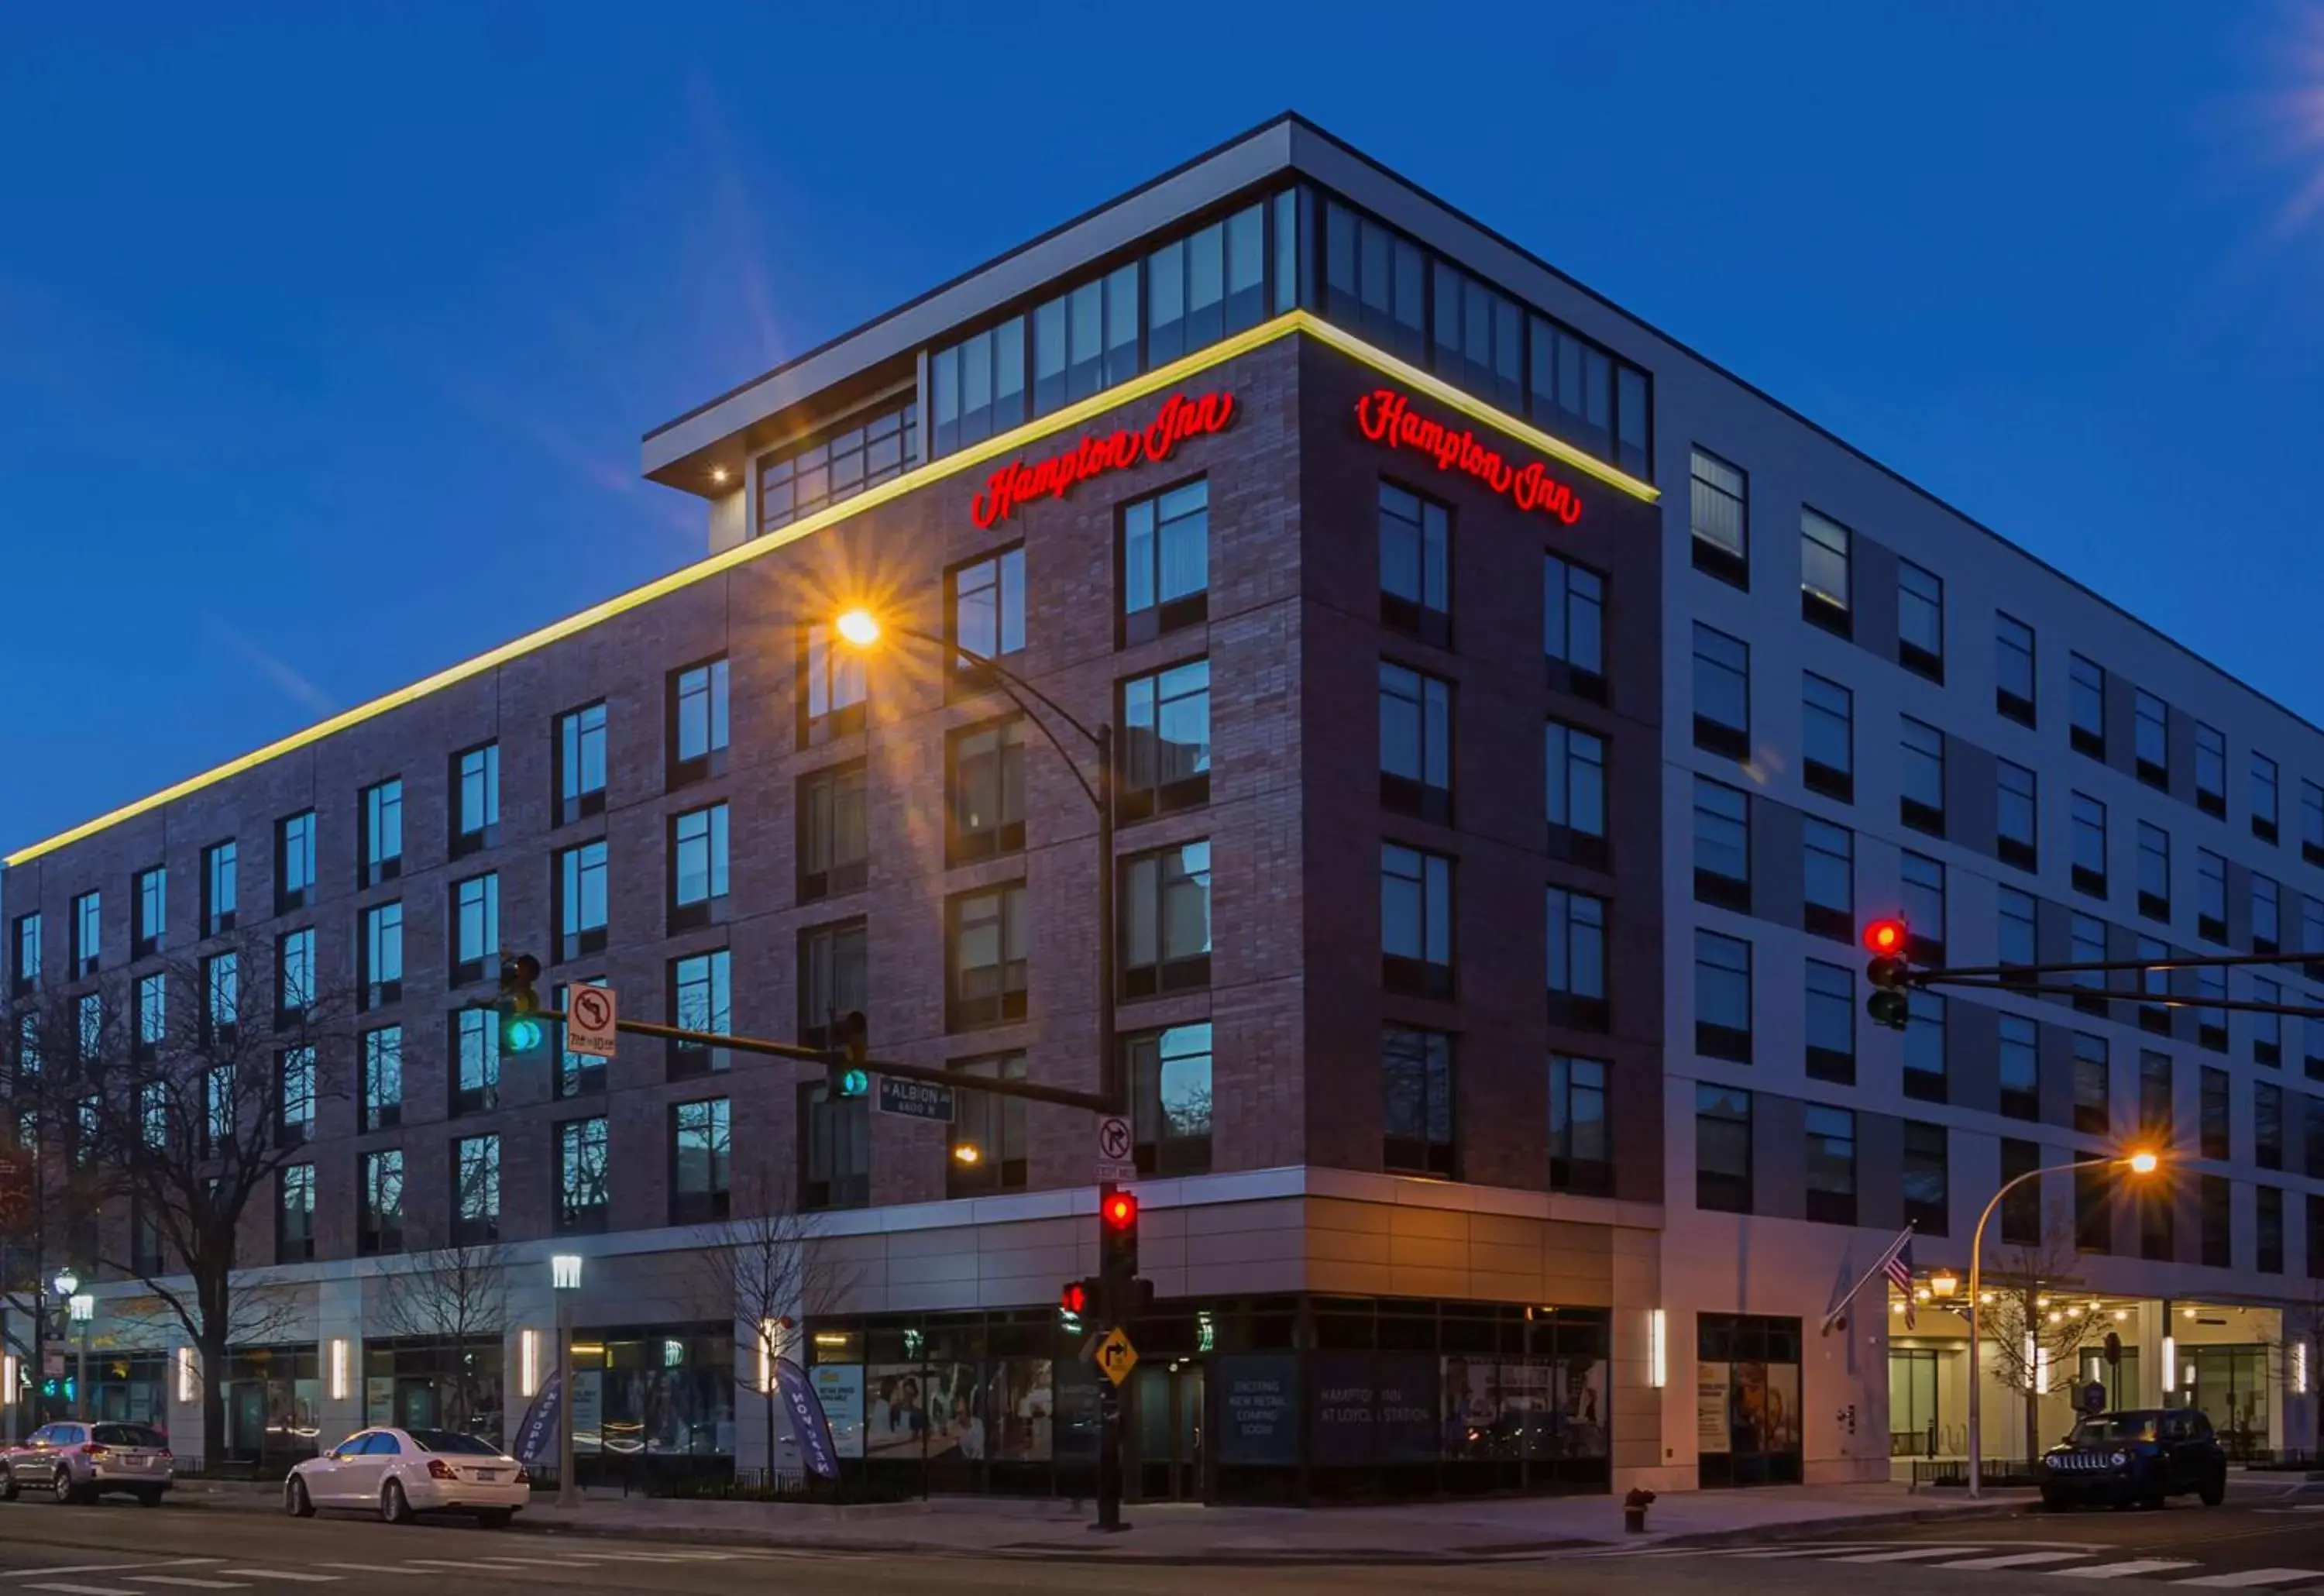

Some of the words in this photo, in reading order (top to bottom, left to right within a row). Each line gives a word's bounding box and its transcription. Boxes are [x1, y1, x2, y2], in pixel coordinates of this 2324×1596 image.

[971, 432, 1142, 529] Hampton
[1144, 393, 1233, 463] Inn
[1358, 390, 1511, 494] Hampton
[1514, 463, 1582, 525] Inn
[892, 1084, 937, 1104] ALBION
[1321, 1408, 1336, 1422] AT
[522, 1422, 543, 1460] OPEN
